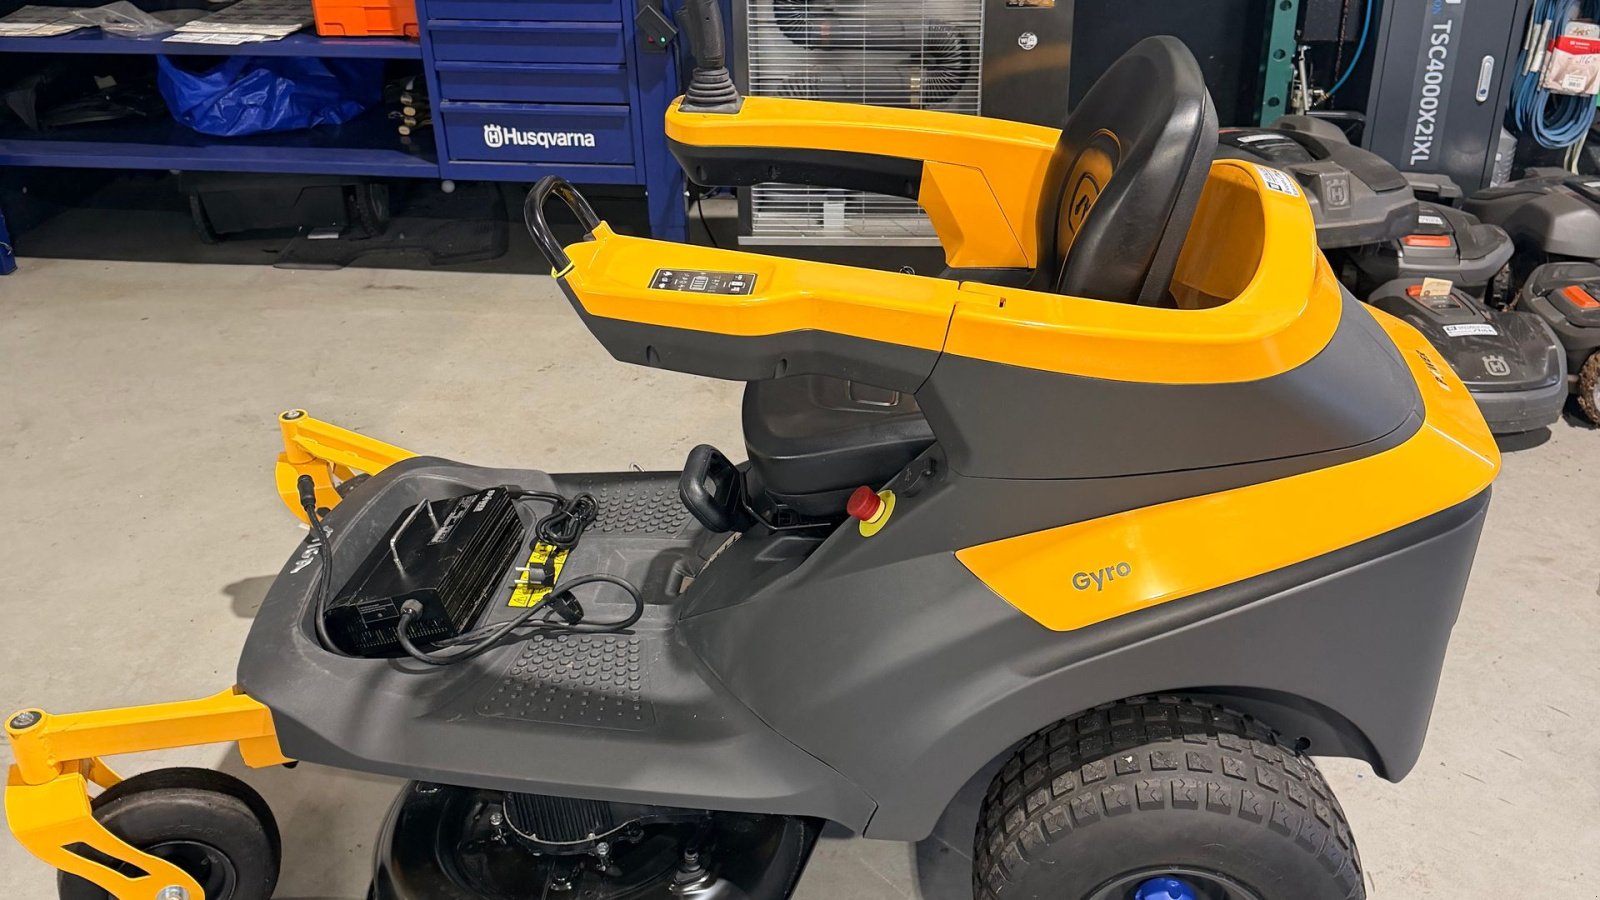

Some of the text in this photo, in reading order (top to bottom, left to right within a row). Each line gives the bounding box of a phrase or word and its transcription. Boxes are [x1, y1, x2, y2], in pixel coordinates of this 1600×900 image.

[1410, 20, 1452, 166] TSC4000X2iXL
[503, 127, 596, 149] Husqvarna
[1072, 561, 1132, 592] Gyro
